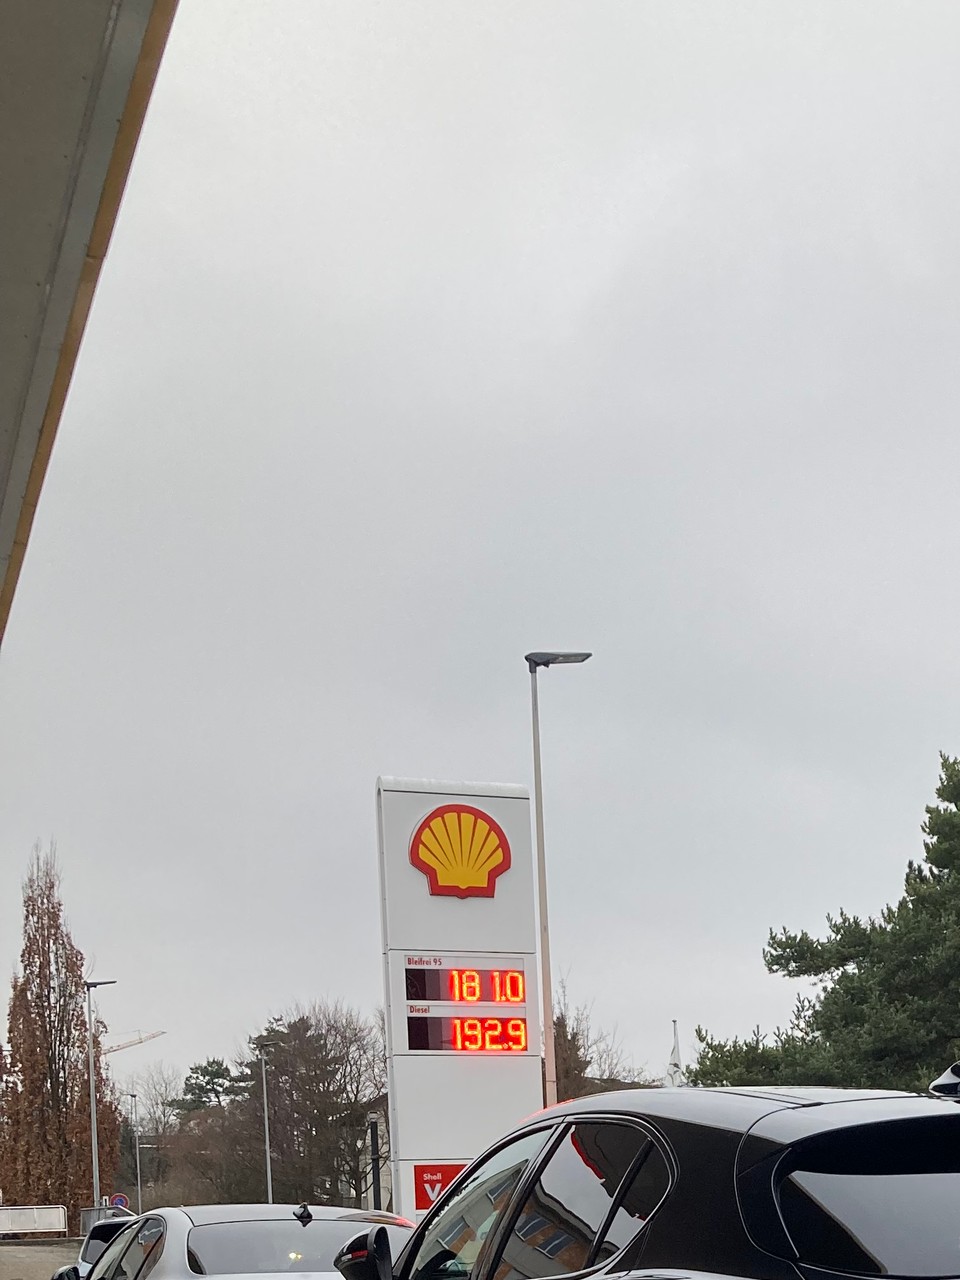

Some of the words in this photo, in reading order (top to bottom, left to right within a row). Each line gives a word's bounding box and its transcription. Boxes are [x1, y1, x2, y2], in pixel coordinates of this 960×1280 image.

[433, 958, 442, 966] 95
[409, 1005, 430, 1013] Diesel
[423, 1173, 442, 1181] Shell
